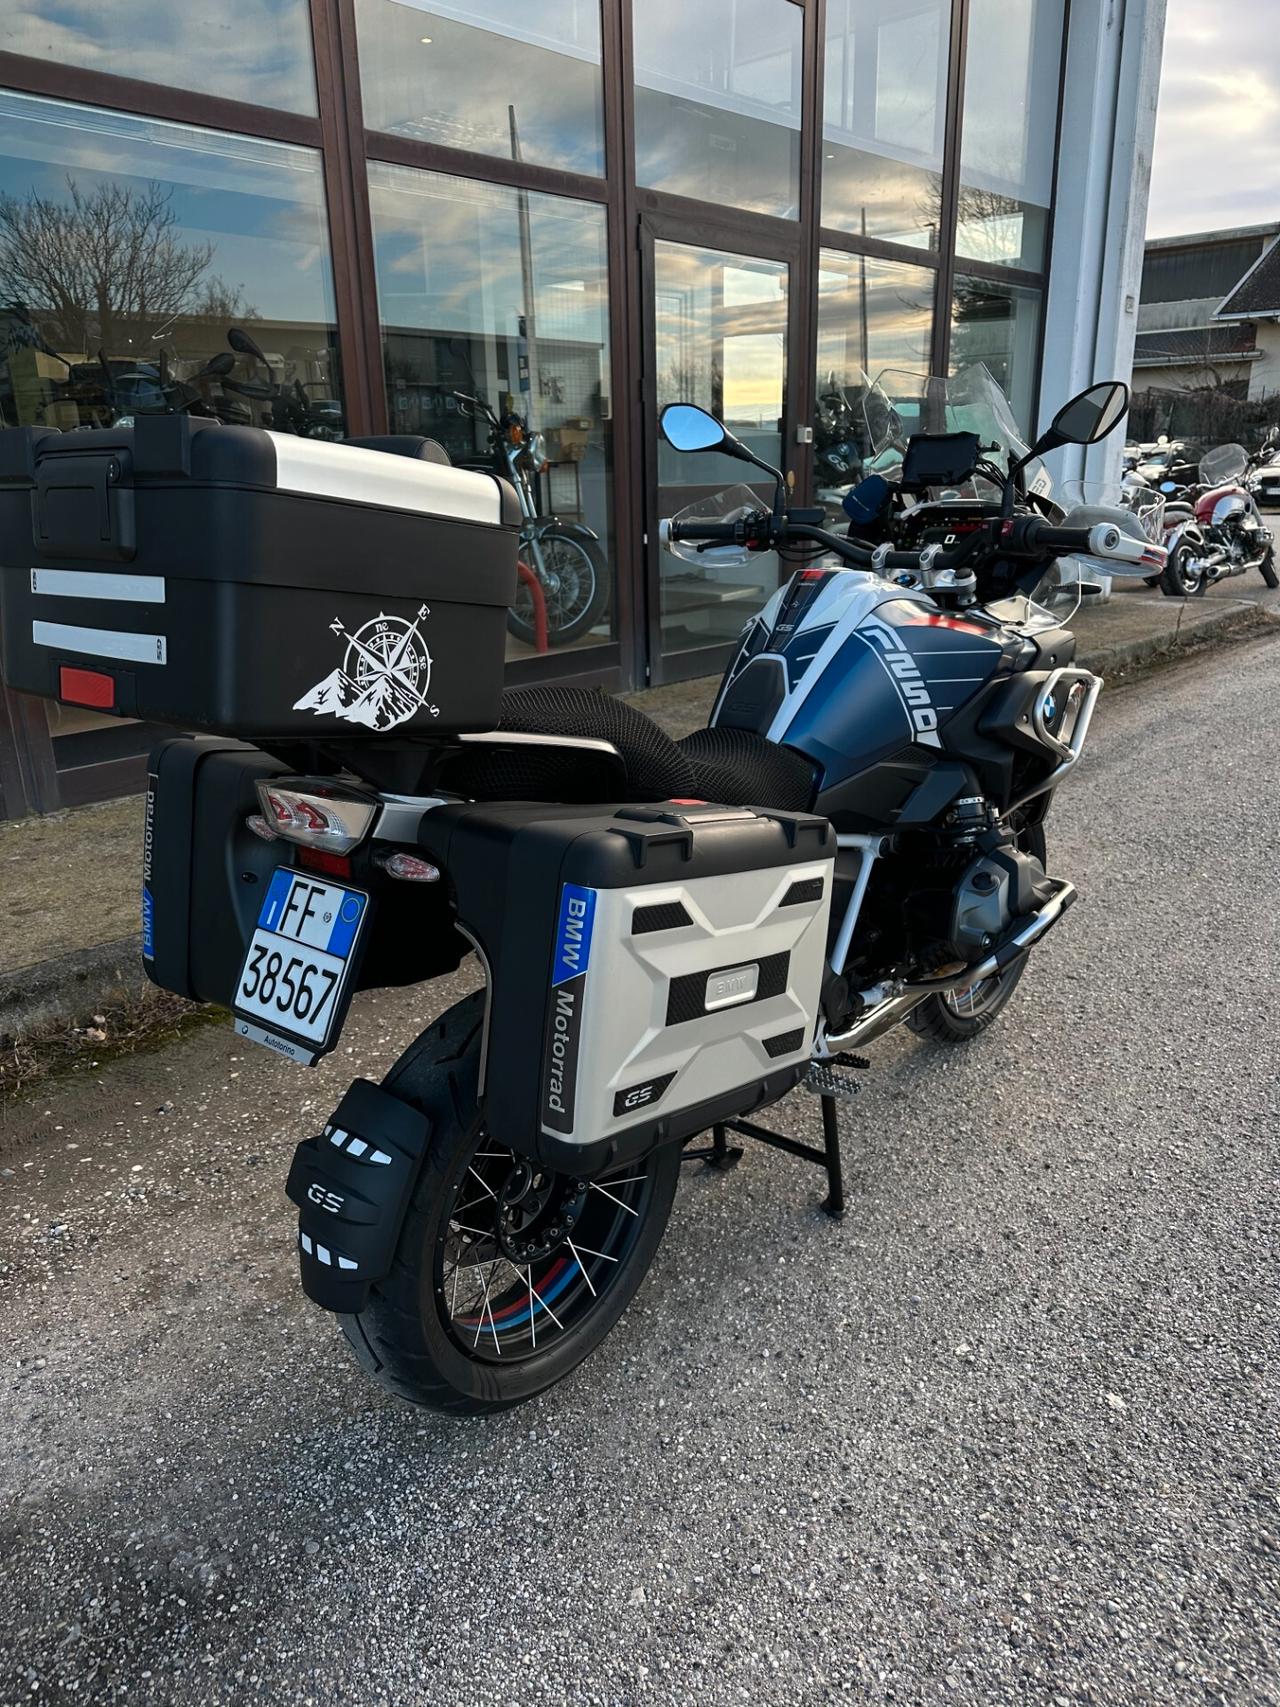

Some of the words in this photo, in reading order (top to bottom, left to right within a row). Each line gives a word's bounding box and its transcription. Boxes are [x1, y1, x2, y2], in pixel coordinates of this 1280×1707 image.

[828, 454, 849, 472] GS
[944, 535, 956, 544] 0
[417, 603, 431, 621] E
[329, 616, 345, 636] N
[375, 621, 389, 633] ne
[776, 624, 795, 632] GS
[418, 655, 427, 670] se
[429, 704, 440, 718] S
[143, 790, 155, 880] Motorrad
[279, 880, 326, 938] FF
[561, 897, 586, 970] BMW
[243, 944, 340, 1025] 38567
[716, 974, 747, 996] BMW
[263, 1034, 296, 1056] Autotorino
[548, 989, 576, 1114] Motorrad
[624, 1086, 653, 1108] GS
[308, 1183, 345, 1213] GS
